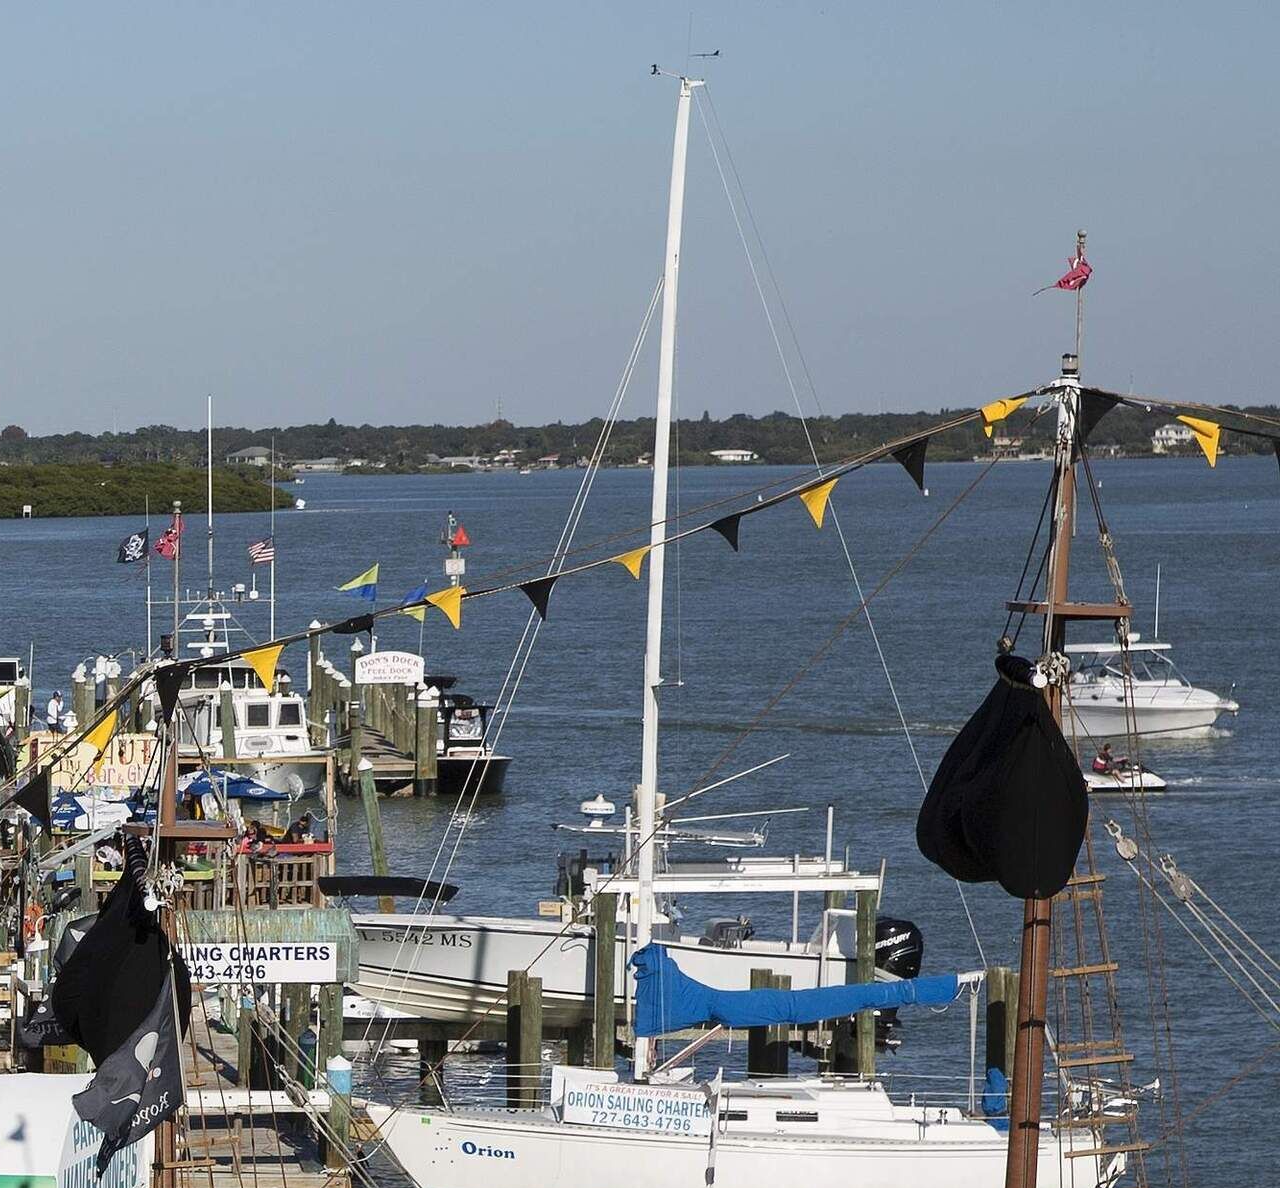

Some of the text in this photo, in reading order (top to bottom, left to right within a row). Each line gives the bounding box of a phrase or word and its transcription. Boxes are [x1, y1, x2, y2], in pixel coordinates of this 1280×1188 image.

[441, 933, 472, 948] MS
[229, 946, 330, 961] CHARTERS
[568, 1091, 605, 1109] ORION
[608, 1094, 653, 1114] SAILING
[592, 1110, 691, 1131] 727-643-4796
[461, 1142, 515, 1159] Orion
